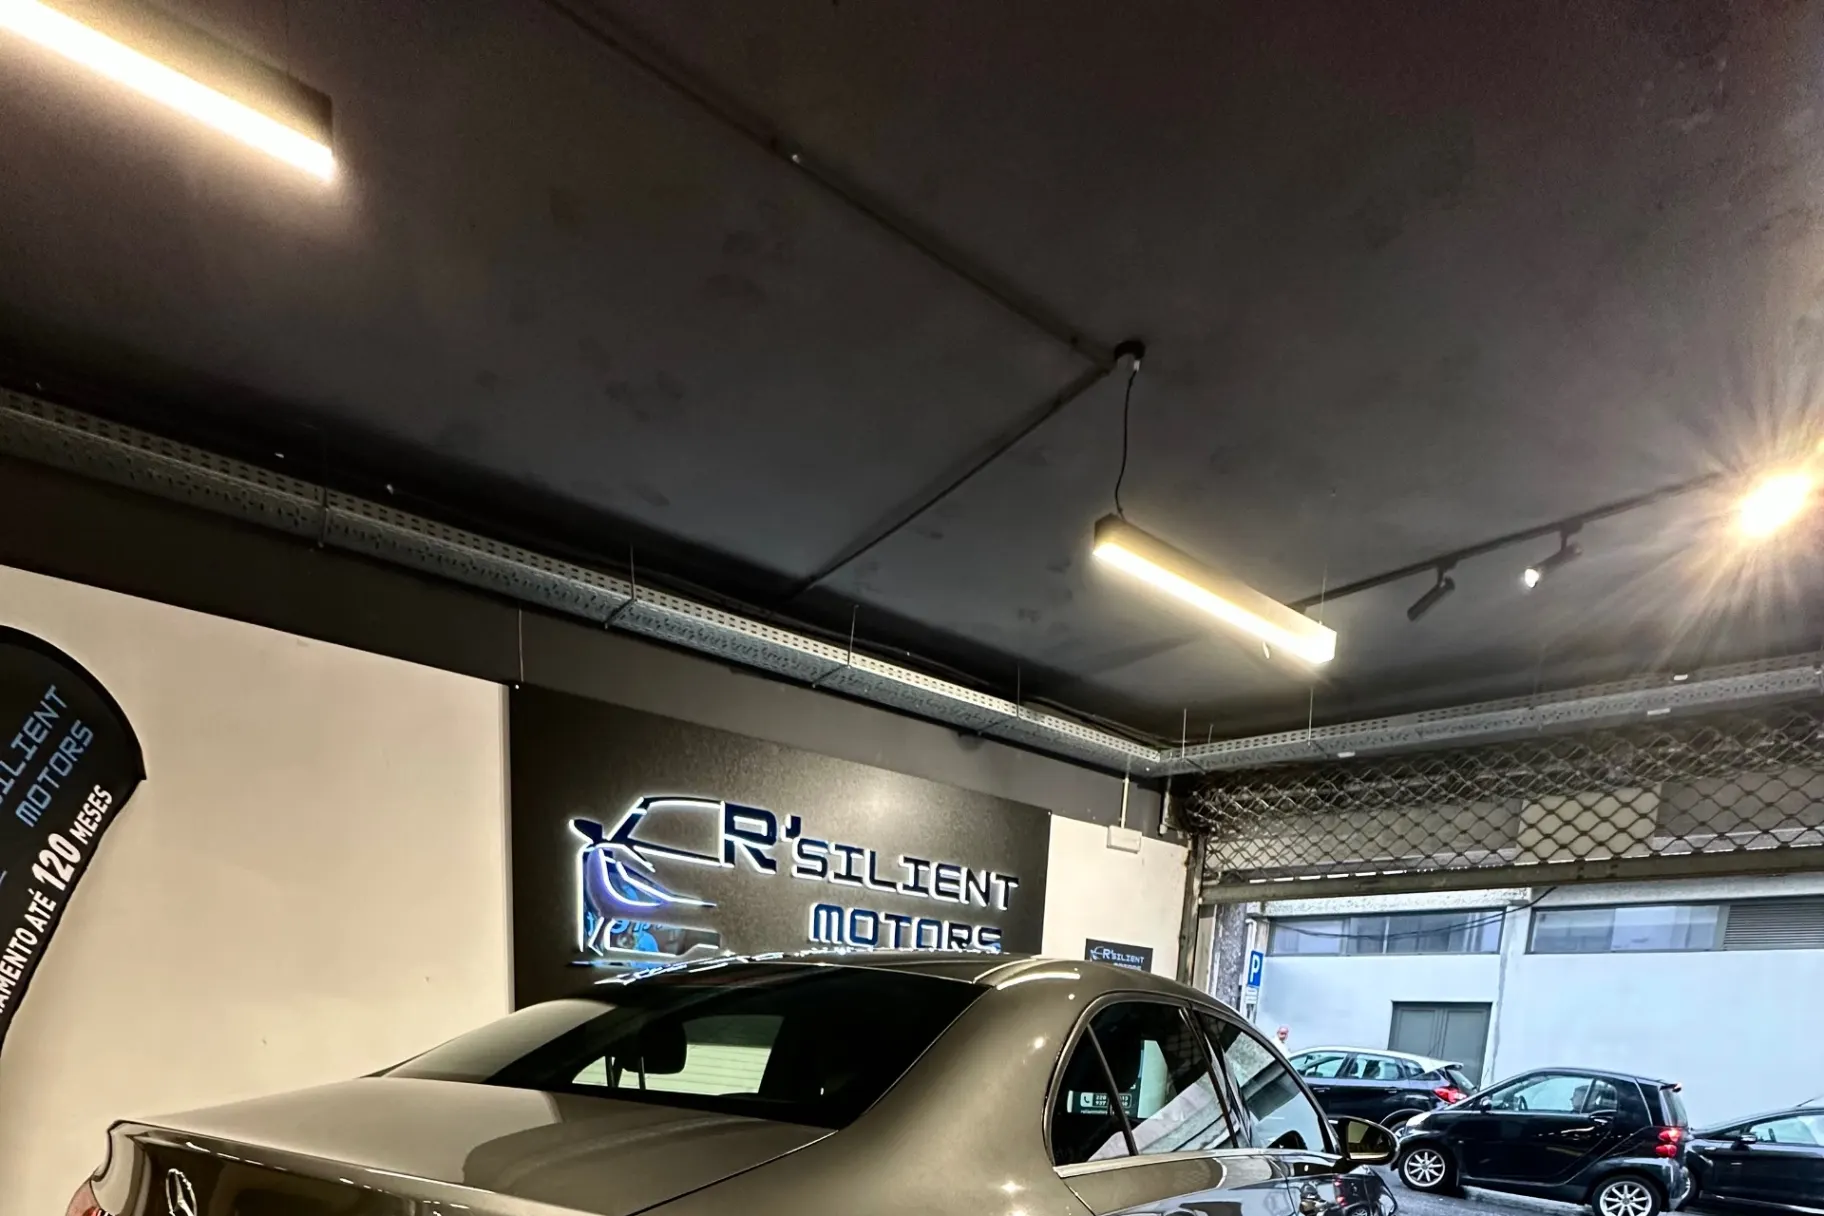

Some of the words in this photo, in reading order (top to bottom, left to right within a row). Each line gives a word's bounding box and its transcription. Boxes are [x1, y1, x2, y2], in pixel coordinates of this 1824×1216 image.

[0, 684, 67, 806] ILIENT
[15, 719, 94, 827] MOTORS
[69, 784, 113, 845] MESES
[31, 833, 82, 891] 120
[720, 800, 1019, 910] R'SILIENT
[24, 888, 57, 933] ATÉ
[808, 903, 1003, 951] MOTORS
[0, 927, 38, 1014] AMENTO
[1250, 954, 1260, 982] P
